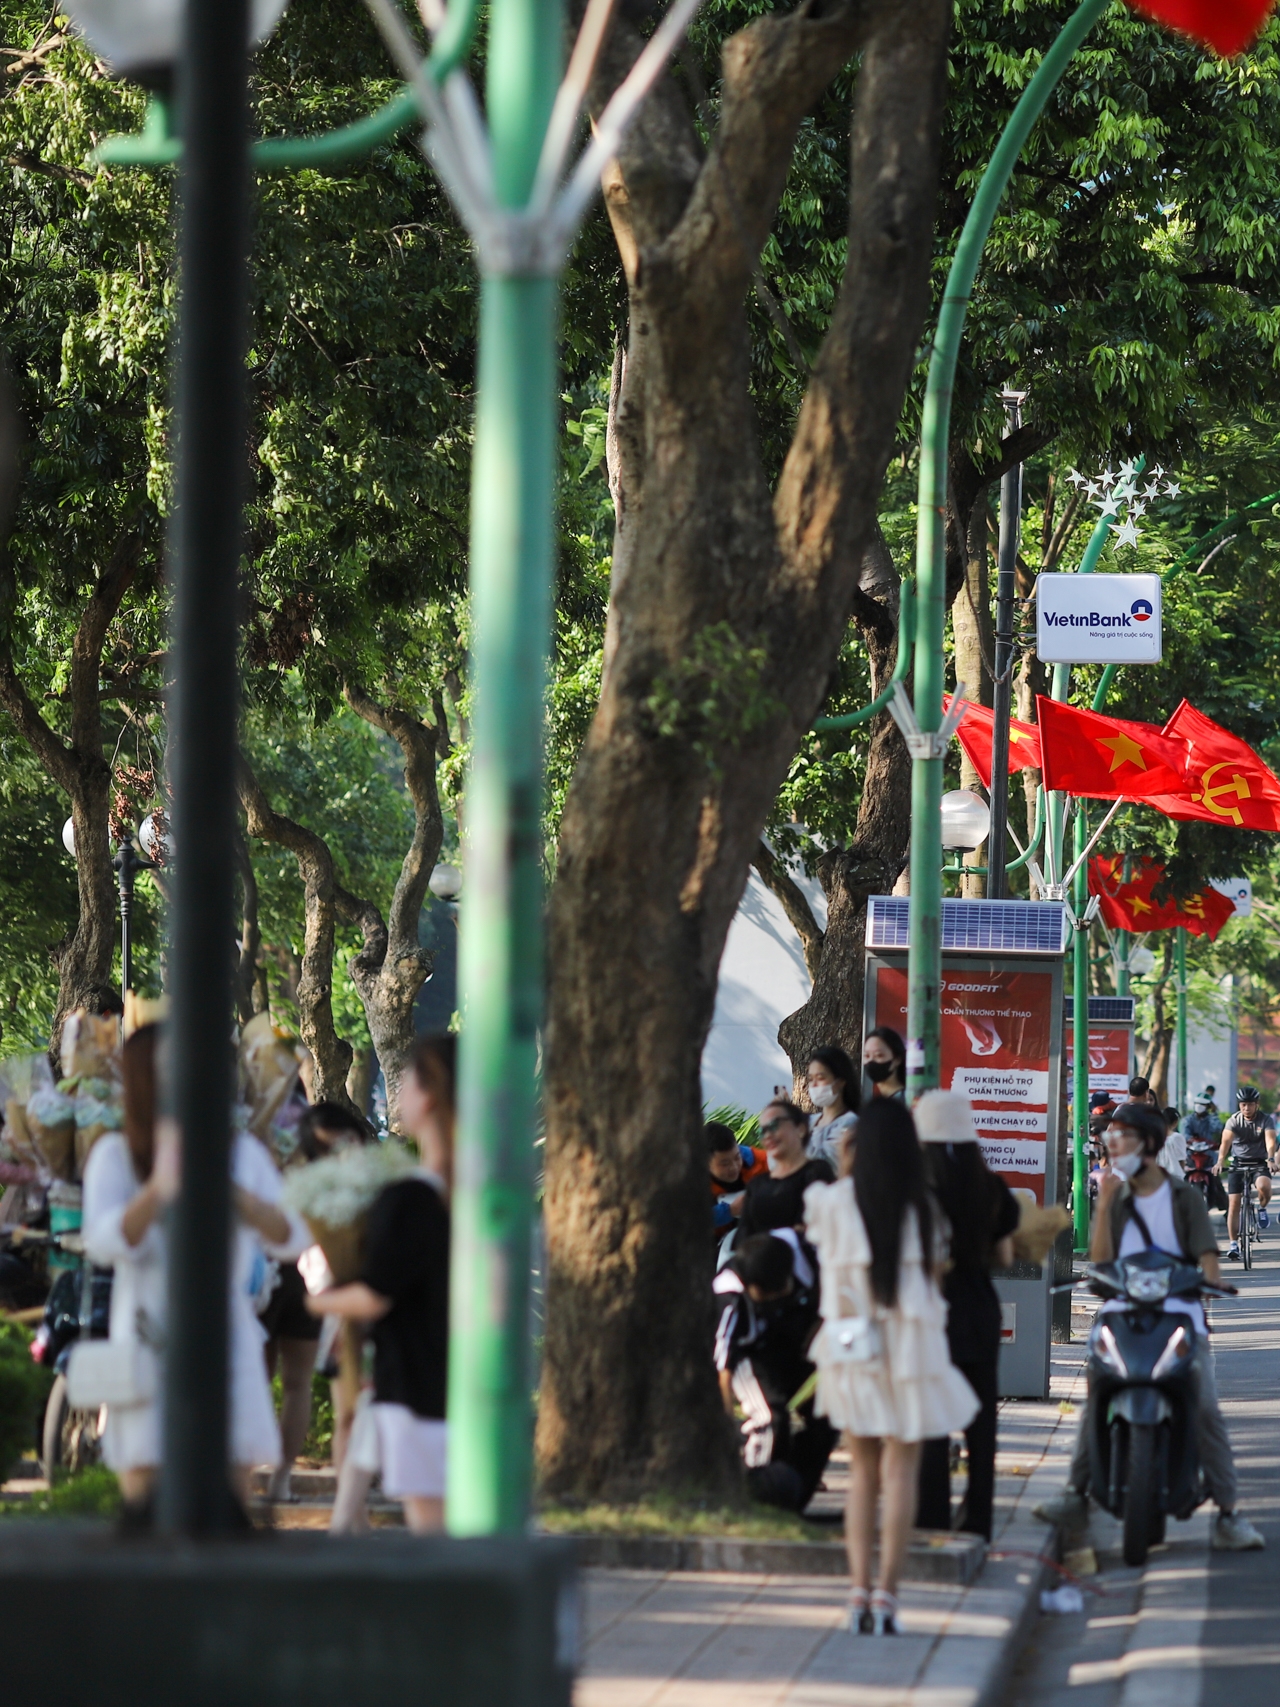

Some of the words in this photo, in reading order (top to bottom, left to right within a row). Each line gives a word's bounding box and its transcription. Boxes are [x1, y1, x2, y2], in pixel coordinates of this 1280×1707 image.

[1043, 612, 1132, 627] VietinBank
[947, 983, 999, 993] GOODFIT
[964, 1076, 981, 1085] PHỤ
[982, 1075, 1001, 1085] KIỆN
[1016, 1077, 1033, 1086] TRỢ
[968, 1086, 992, 1095] CHẤN
[994, 1088, 1028, 1096] THƯƠNG
[981, 1117, 1000, 1126] KIỆN
[1001, 1118, 1025, 1128] CHẠY
[1026, 1118, 1038, 1128] BỘ
[1003, 1147, 1016, 1155] CỤ
[1002, 1156, 1014, 1165] CÁ
[1015, 1157, 1039, 1166] NHÂN
